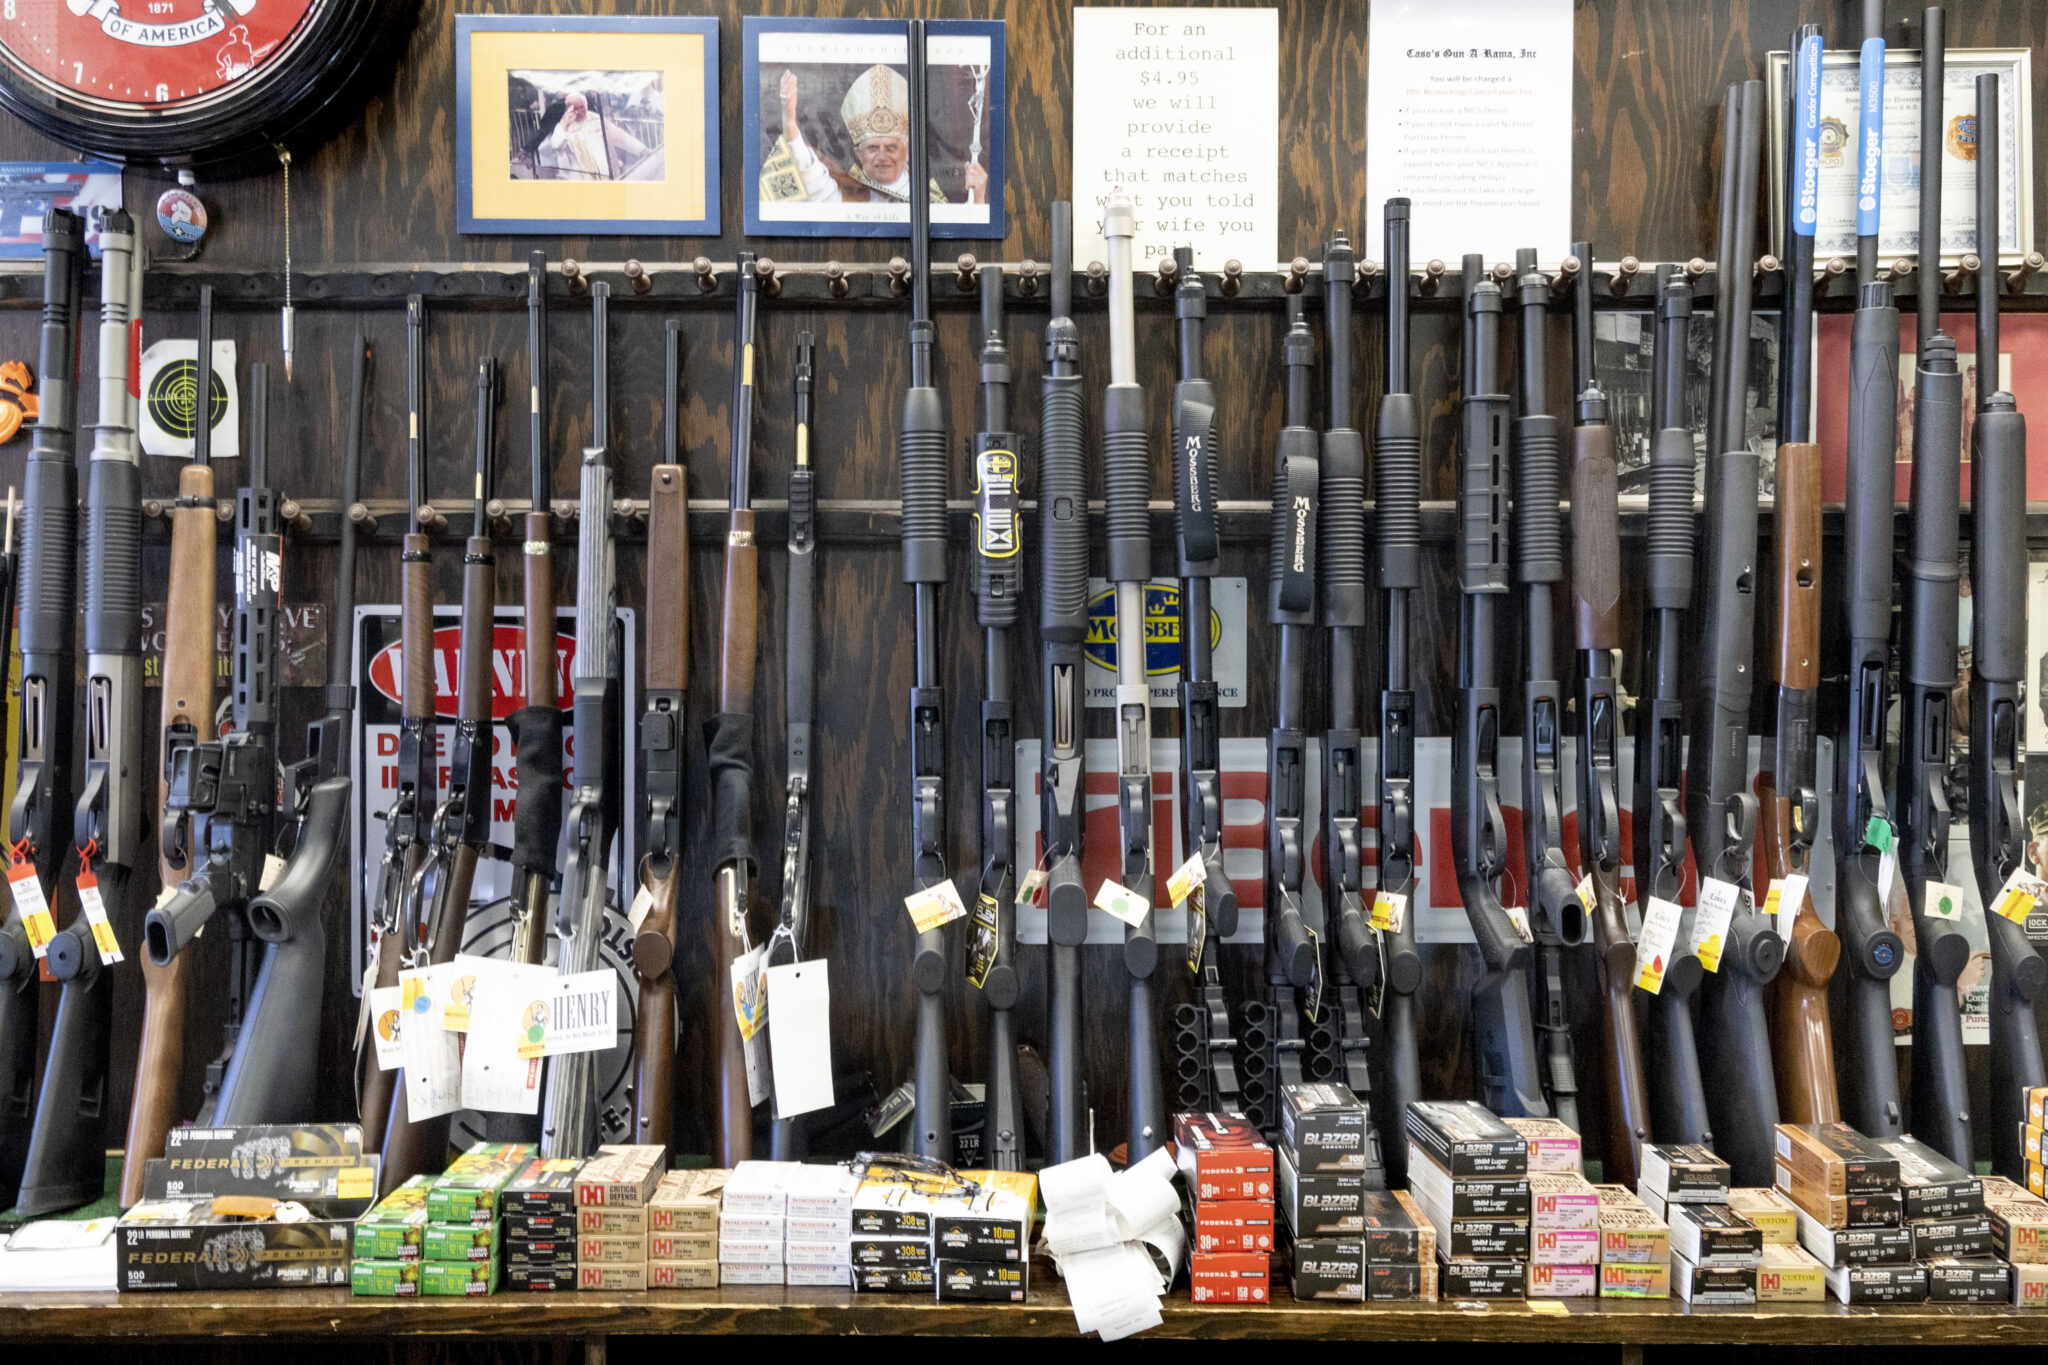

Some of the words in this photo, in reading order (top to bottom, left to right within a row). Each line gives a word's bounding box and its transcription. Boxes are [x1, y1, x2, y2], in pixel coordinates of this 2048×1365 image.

[148, 3, 173, 14] 1871
[110, 21, 131, 37] OF
[139, 18, 220, 42] AMERICA
[1134, 23, 1169, 36] For
[1183, 25, 1206, 36] an
[1115, 47, 1235, 61] additional
[1406, 48, 1440, 59] Caso's
[1519, 48, 1537, 58] Inc
[73, 62, 84, 84] 7
[1808, 42, 1819, 95] Competition
[1140, 70, 1199, 86] $4.95
[156, 83, 169, 102] 6
[1868, 81, 1878, 113] M3500
[1133, 98, 1157, 109] we
[1169, 95, 1217, 110] will
[1807, 97, 1818, 129] Condor
[1127, 120, 1212, 137] provide
[1121, 147, 1131, 158] a
[1146, 144, 1230, 162] receipt
[1861, 127, 1880, 201] Stoeger
[1103, 168, 1148, 182] that
[1163, 169, 1248, 182] matches
[1801, 137, 1819, 207] Stoeger
[1095, 194, 1143, 207] wt
[1157, 196, 1192, 211] you
[1207, 194, 1254, 207] told
[1095, 220, 1144, 235] yr
[1156, 217, 1205, 231] wife
[1218, 220, 1254, 235] you
[1186, 436, 1201, 511] MOSSBERG
[1293, 496, 1310, 573] MOSSBERG
[265, 550, 280, 593] M&P
[553, 991, 610, 1031] HENRY
[171, 1131, 182, 1146] 22
[190, 1130, 213, 1140] PERSONAL
[960, 1140, 969, 1148] 22
[970, 1139, 979, 1148] LR
[1304, 1133, 1360, 1145] BLAZER
[1454, 1144, 1493, 1154] BLAZER
[170, 1158, 251, 1170] FEDERAL
[167, 1181, 184, 1190] 500
[1201, 1184, 1212, 1198] 38
[1455, 1185, 1494, 1194] BLAZER
[1909, 1186, 1948, 1199] BLAZER
[1303, 1195, 1359, 1207] BLAZER
[902, 1215, 916, 1226] 308
[1348, 1216, 1363, 1224] 100
[993, 1227, 1015, 1239] 10mm
[1453, 1224, 1493, 1233] BLAZER
[1917, 1225, 1956, 1237] BLAZER
[127, 1230, 138, 1245] 22
[146, 1230, 170, 1239] PERSONAL
[1200, 1235, 1211, 1249] 38
[1836, 1233, 1876, 1244] BLAZER
[128, 1252, 219, 1264] FEDERAL
[261, 1250, 339, 1258] PREMIUM
[901, 1246, 915, 1256] 308
[1302, 1261, 1358, 1274] BLAZER
[1449, 1266, 1489, 1275] BLAZER
[1933, 1269, 1973, 1278] BLAZER
[128, 1270, 145, 1279] 500
[907, 1271, 922, 1281] 308
[998, 1269, 1020, 1281] 10mm
[1851, 1271, 1891, 1282] BLAZER
[1195, 1287, 1206, 1301] 38
[1346, 1284, 1362, 1292] 100
